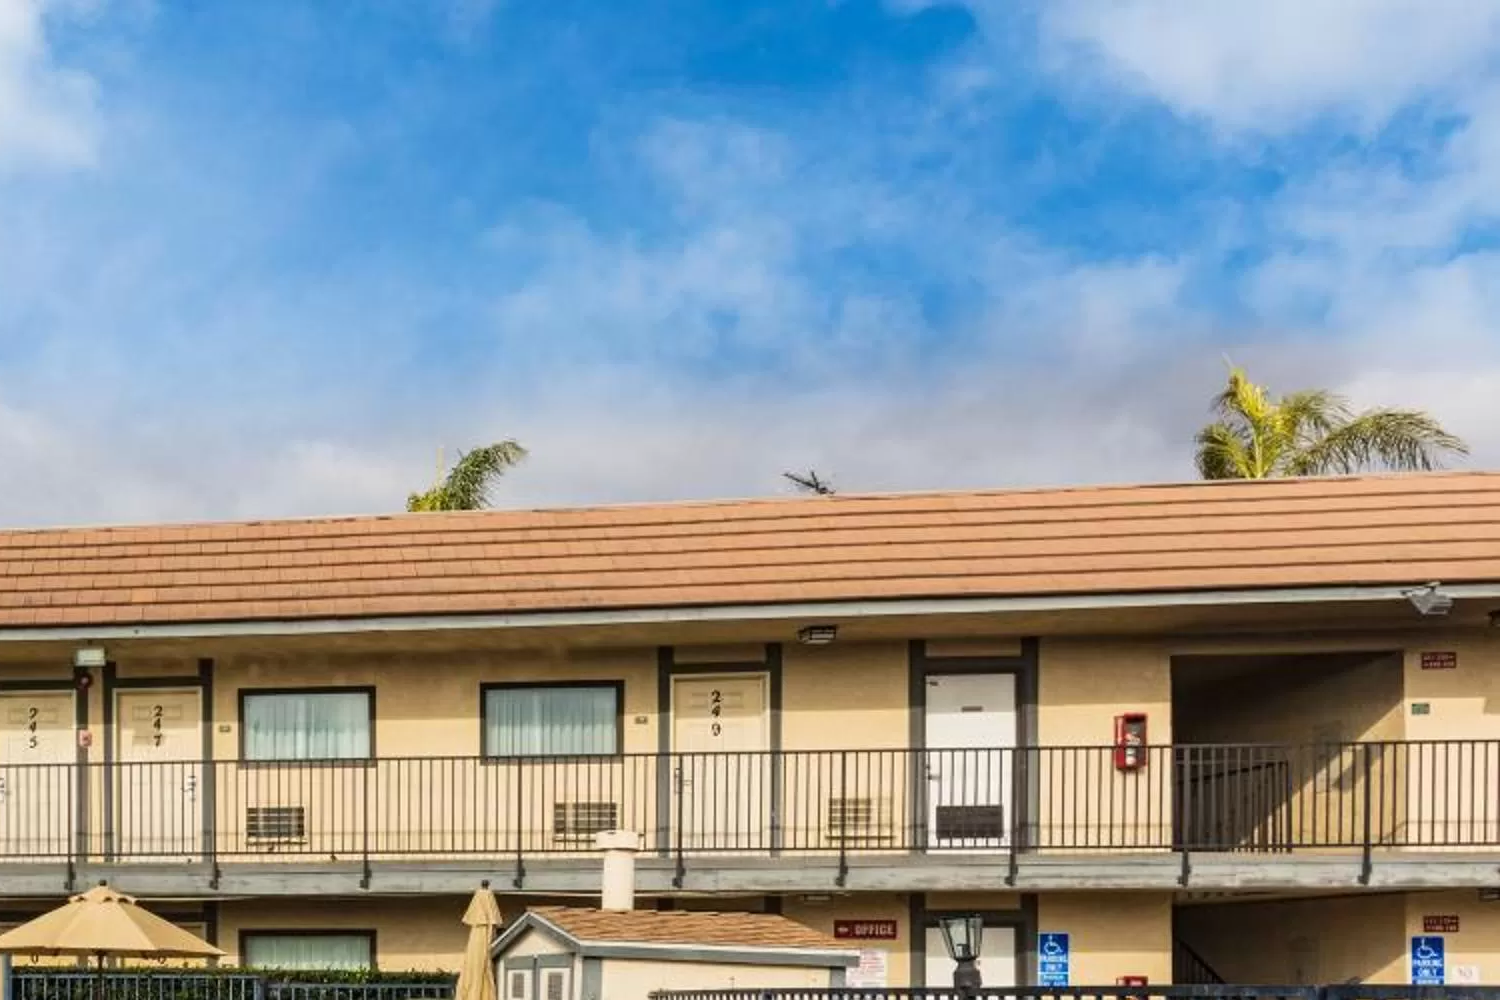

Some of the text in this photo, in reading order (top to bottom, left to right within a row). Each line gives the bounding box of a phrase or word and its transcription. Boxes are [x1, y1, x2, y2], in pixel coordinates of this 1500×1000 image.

[28, 707, 39, 750] 245
[150, 705, 163, 748] 247
[710, 689, 722, 737] 249
[854, 923, 895, 936] OFFICE
